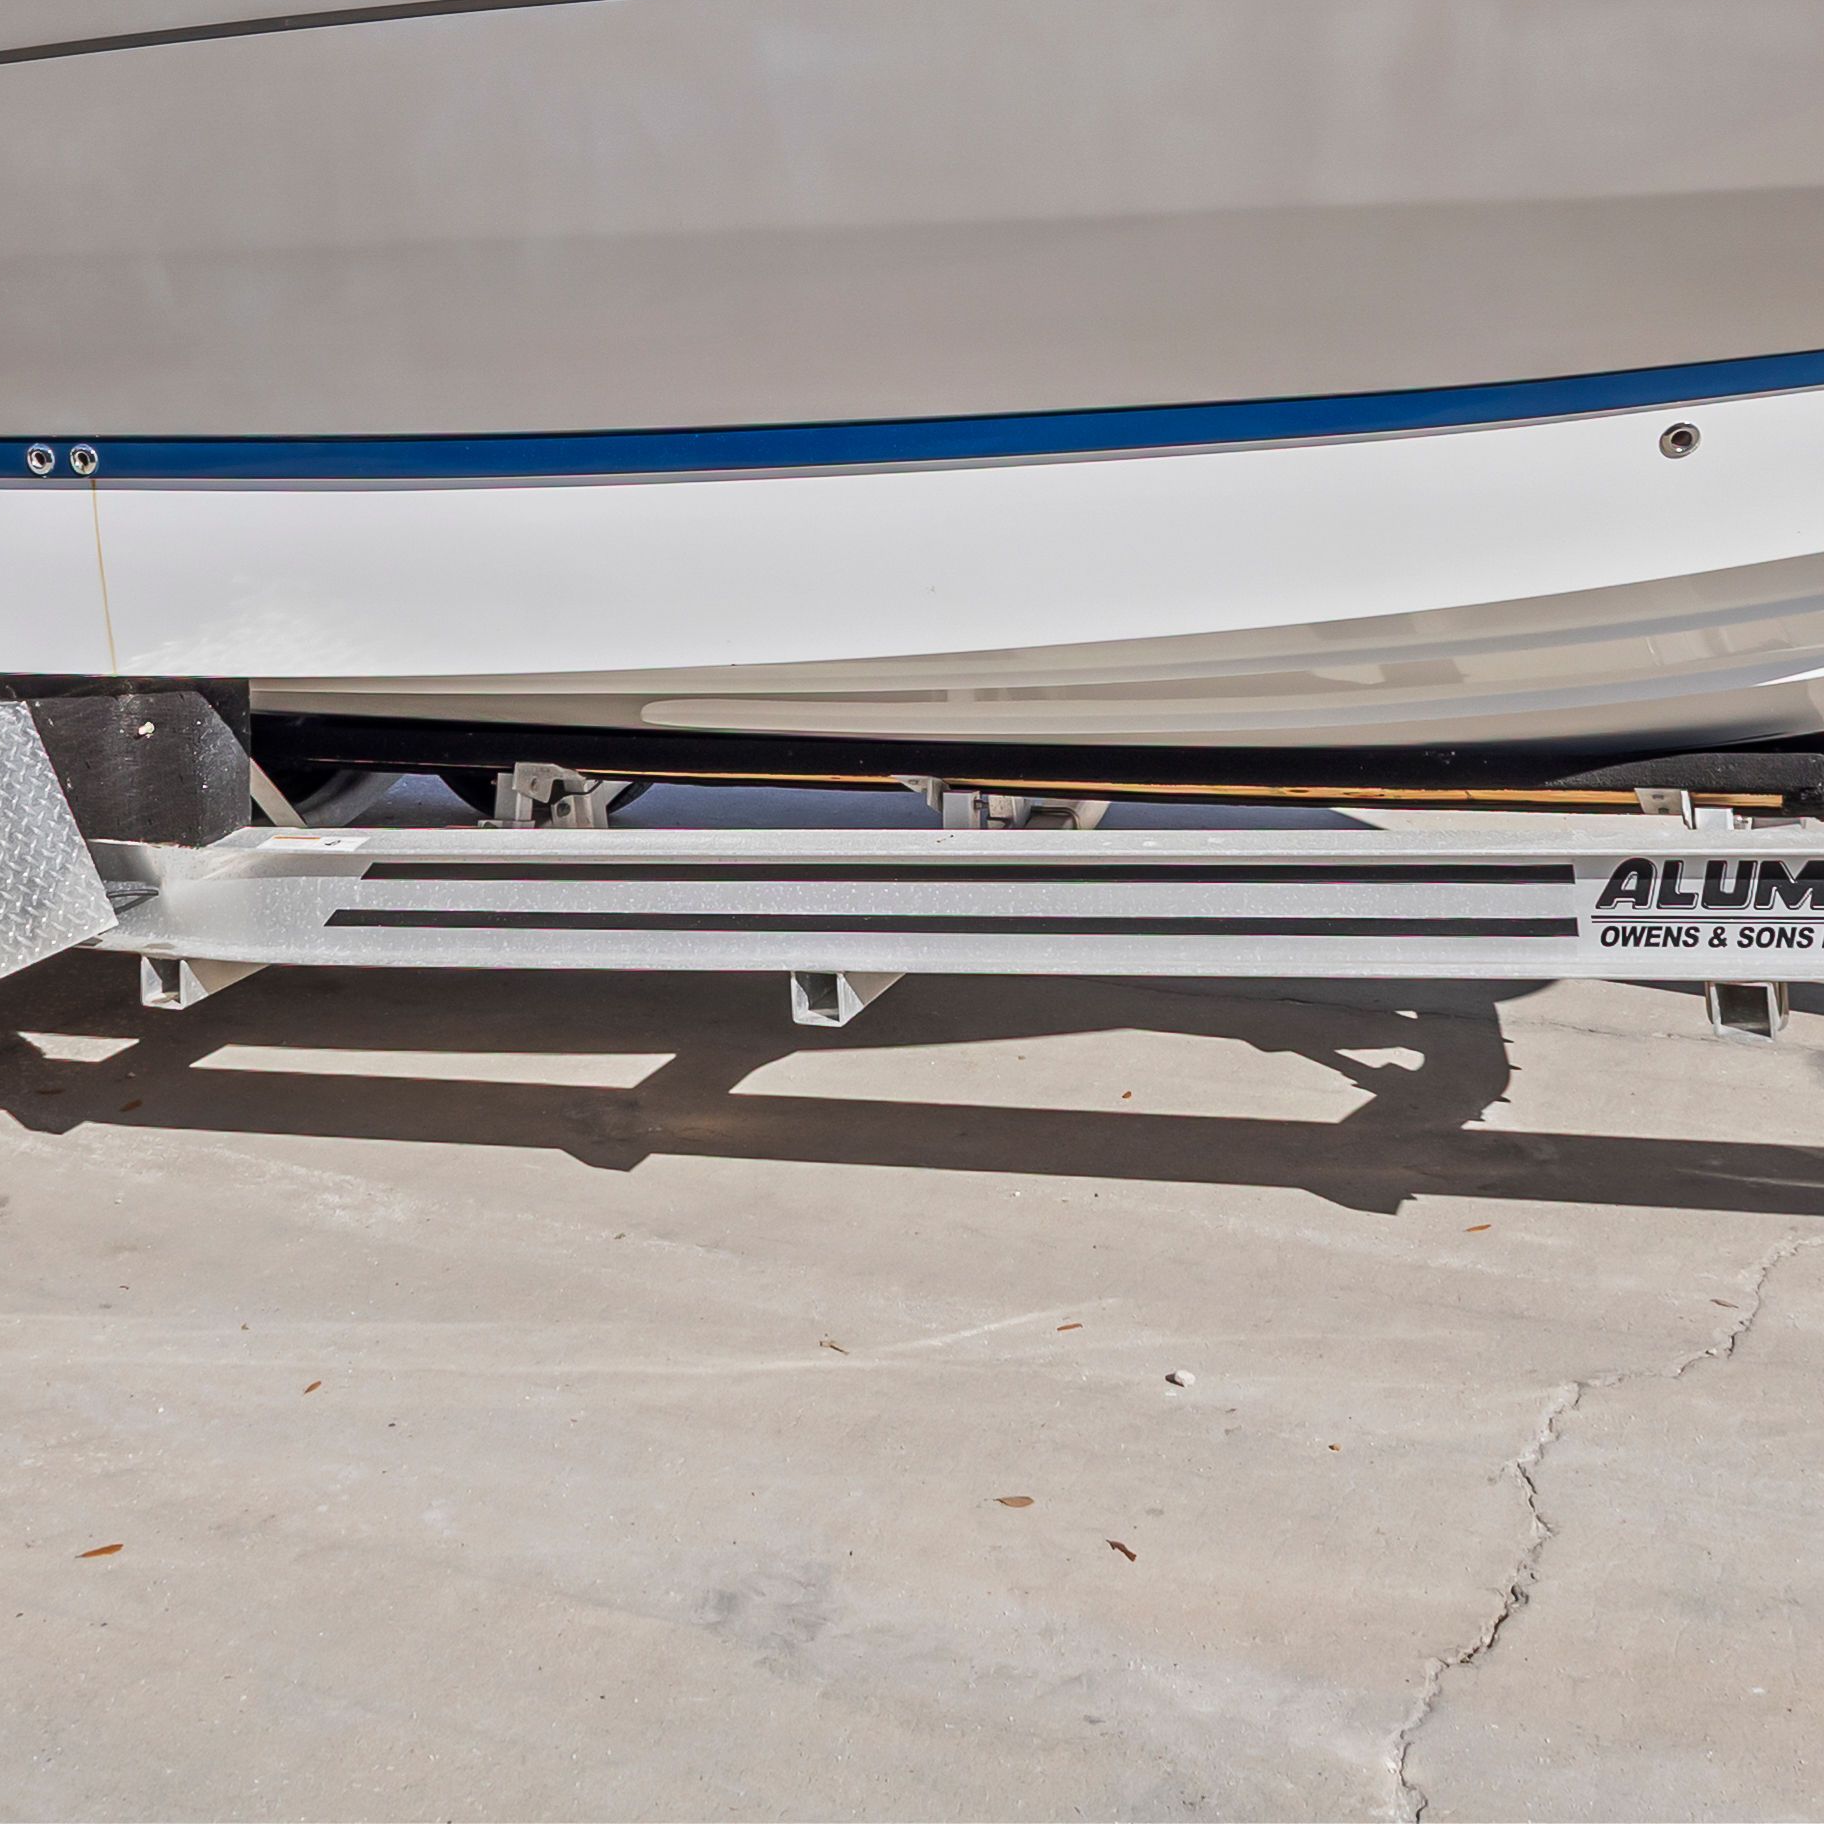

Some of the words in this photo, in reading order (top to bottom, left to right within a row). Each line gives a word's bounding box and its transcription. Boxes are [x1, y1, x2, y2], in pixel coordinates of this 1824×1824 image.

[1600, 925, 1701, 948] OWENS
[1708, 926, 1728, 948] &
[1737, 927, 1814, 949] SONS
